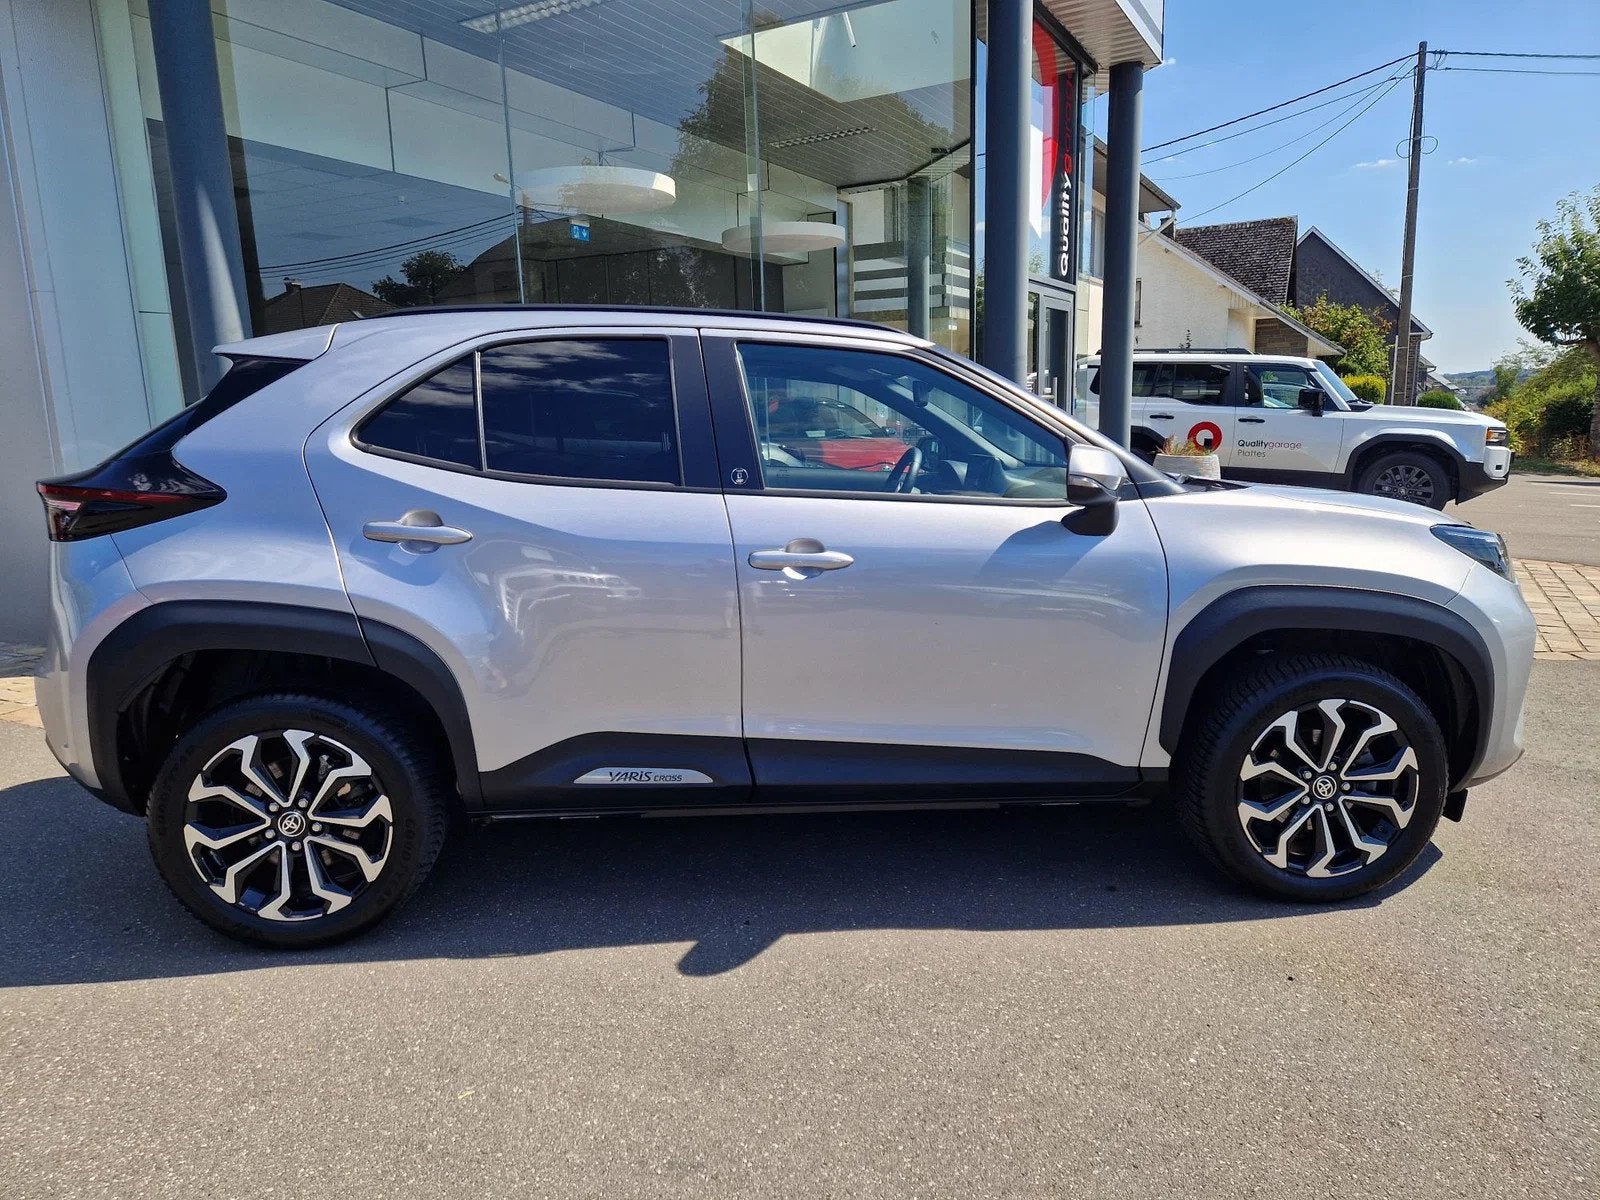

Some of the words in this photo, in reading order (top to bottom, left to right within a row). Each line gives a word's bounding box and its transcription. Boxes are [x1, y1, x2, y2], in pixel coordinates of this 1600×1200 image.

[1237, 439, 1302, 450] Qualitygarage
[1237, 448, 1266, 458] Plattes
[653, 774, 682, 782] CROSS
